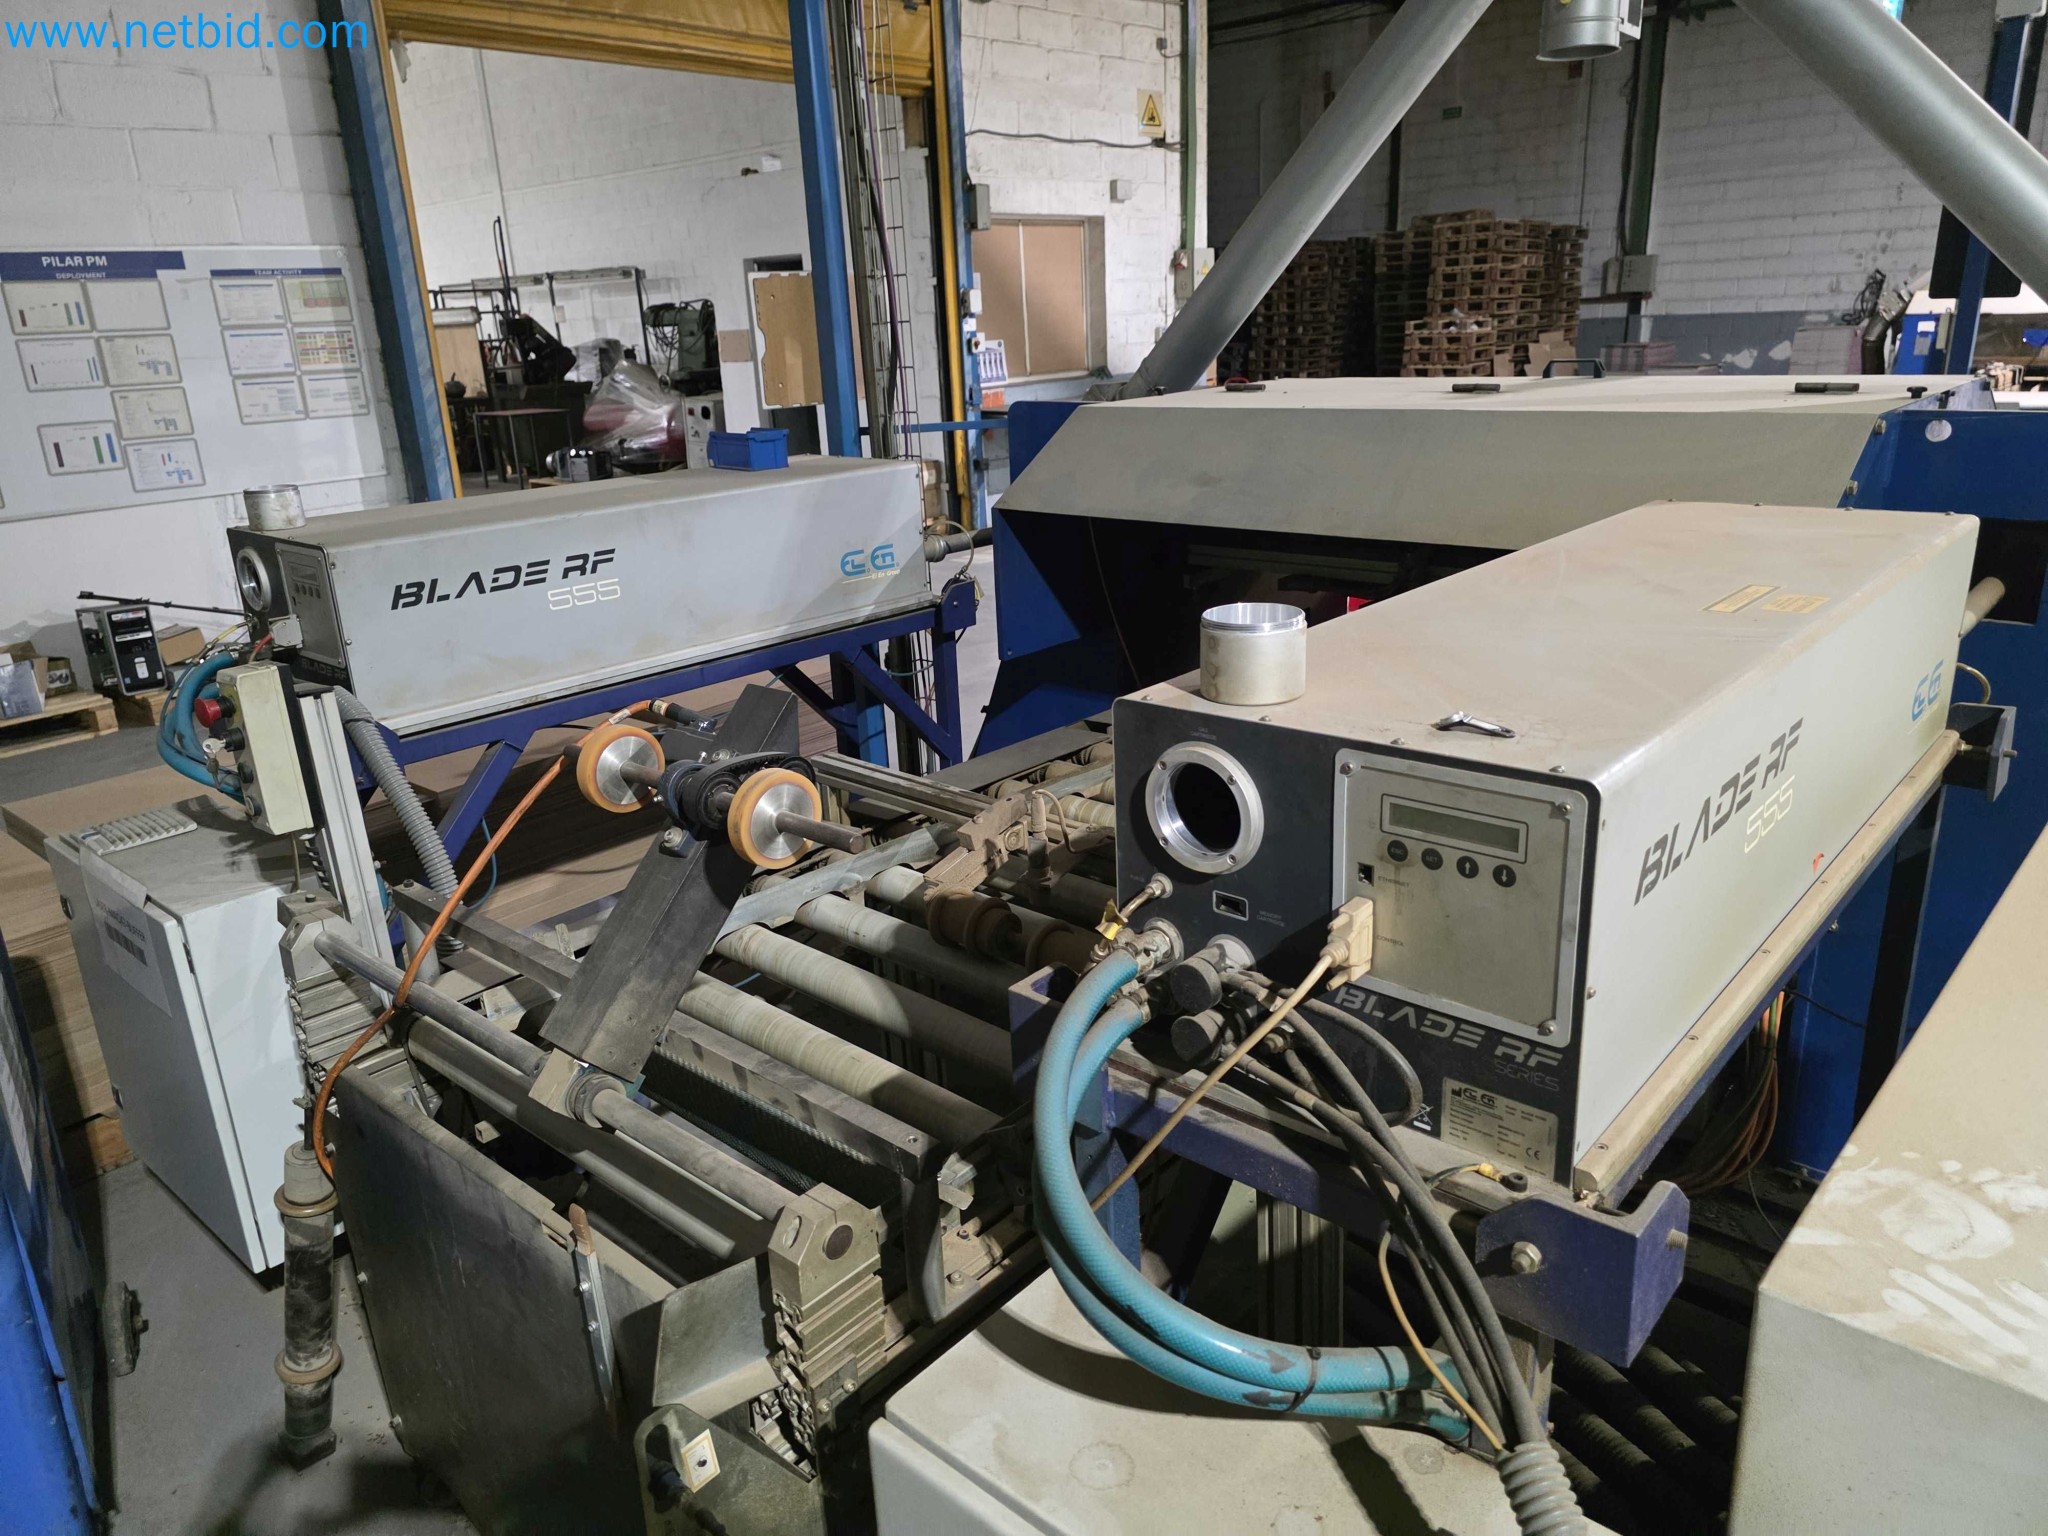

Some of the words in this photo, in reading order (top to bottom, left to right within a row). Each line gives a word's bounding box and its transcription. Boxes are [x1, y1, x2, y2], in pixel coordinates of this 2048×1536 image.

[42, 256, 83, 267] PILAR
[86, 255, 108, 266] PM
[56, 271, 106, 280] DEPLOYMENT
[391, 559, 550, 610] BLADE
[561, 548, 616, 580] RF
[547, 578, 621, 611] 555
[1633, 754, 1761, 907] BLADE
[1761, 716, 1804, 791] RF
[1744, 774, 1796, 854] 555
[1378, 876, 1410, 888] ETHERNET
[1376, 934, 1404, 947] CONTROL
[1334, 986, 1486, 1049] BLADE
[1494, 1036, 1564, 1068] RF
[1494, 1060, 1560, 1092] SERIES
